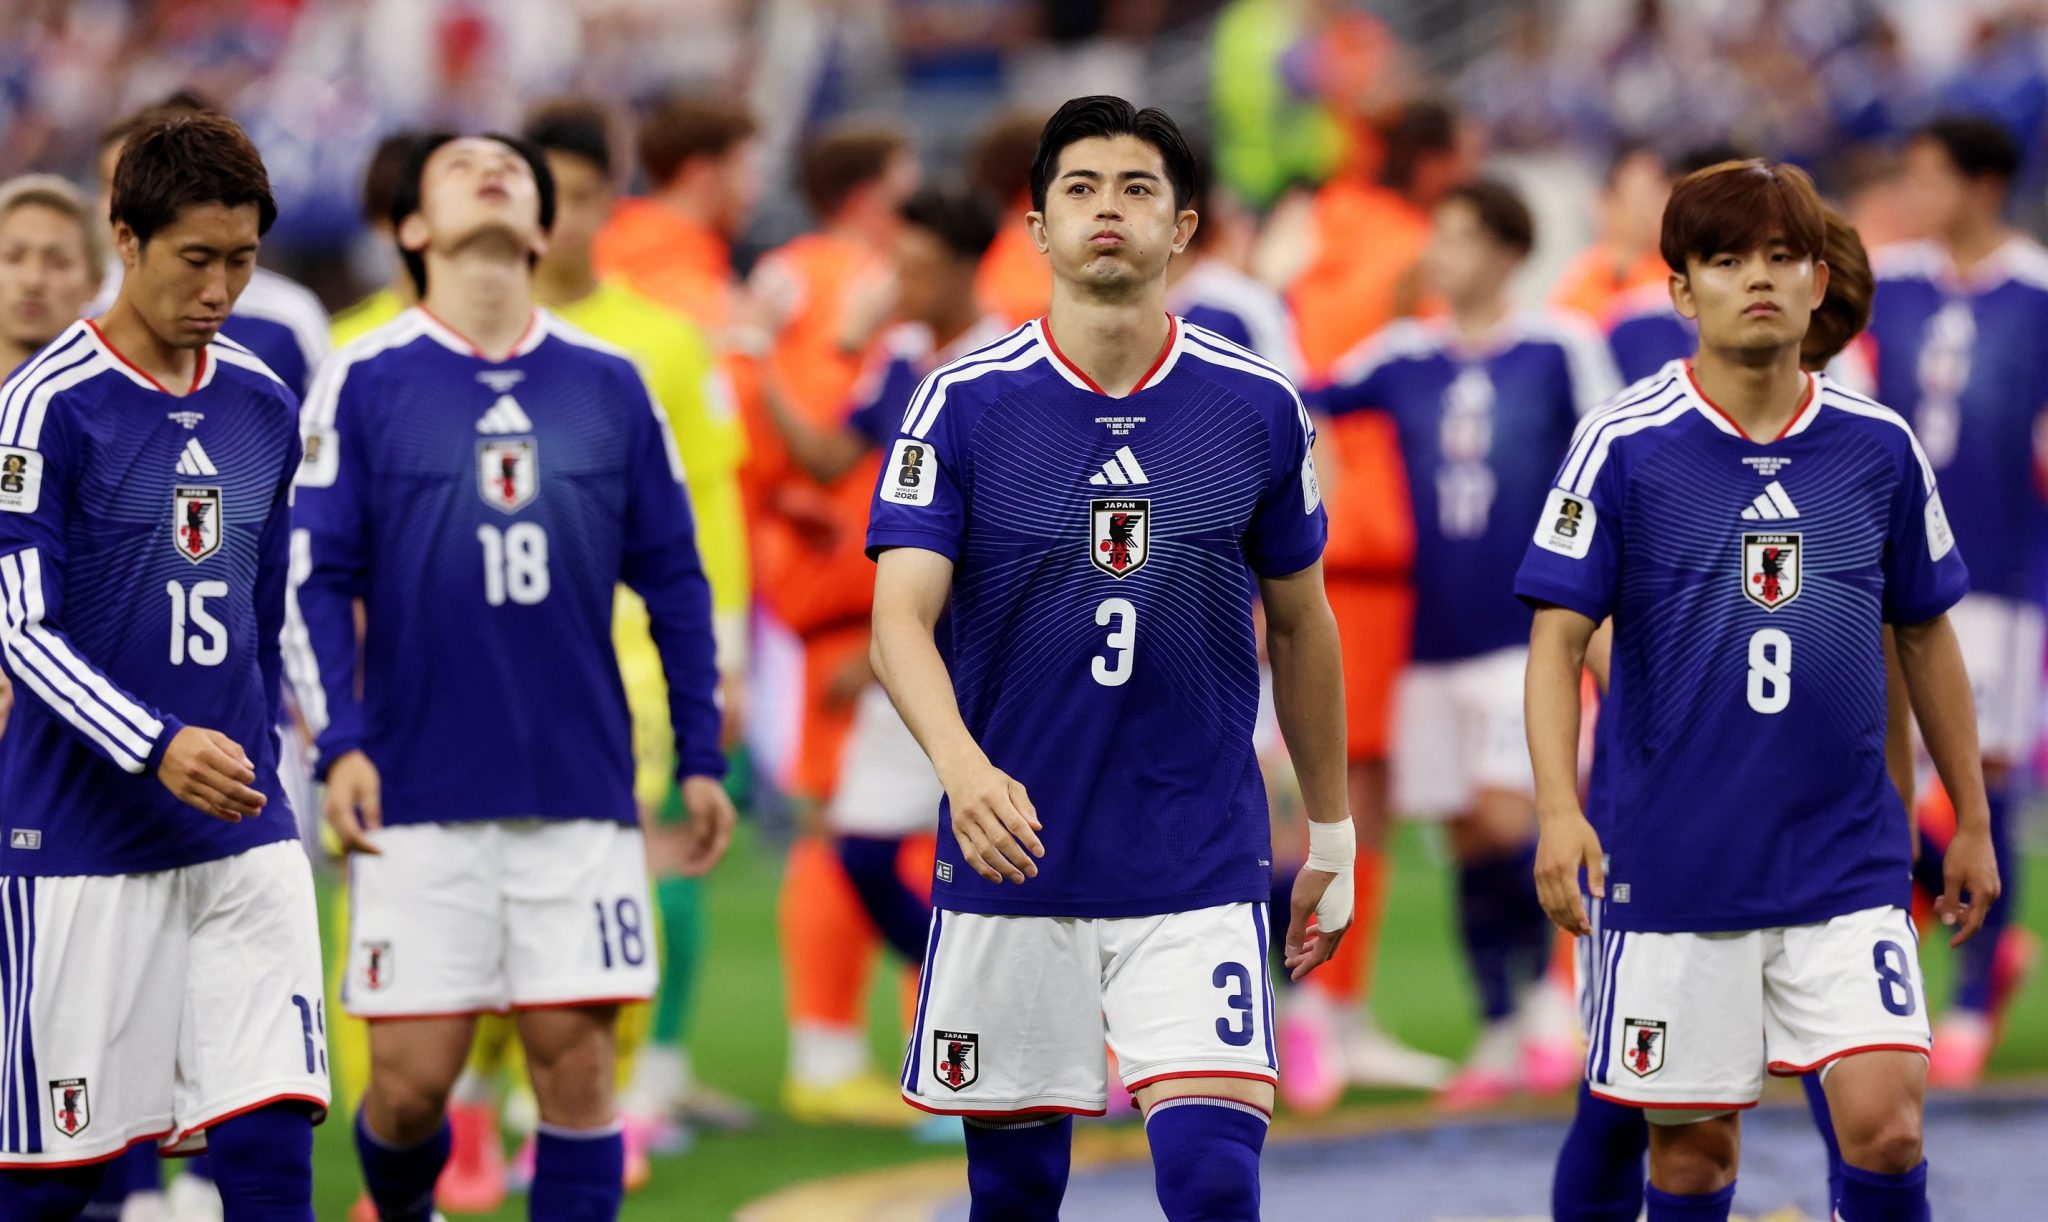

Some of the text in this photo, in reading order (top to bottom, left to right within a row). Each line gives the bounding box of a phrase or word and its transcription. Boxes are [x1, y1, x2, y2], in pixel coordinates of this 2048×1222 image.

[894, 491, 918, 500] 2026
[476, 521, 551, 608] 18
[166, 580, 229, 667] 15
[1091, 598, 1137, 687] 3
[1747, 628, 1792, 714] 8
[595, 898, 646, 969] 18
[1212, 961, 1254, 1047] 3
[1873, 940, 1916, 1017] 8
[944, 1032, 968, 1040] JAPAN
